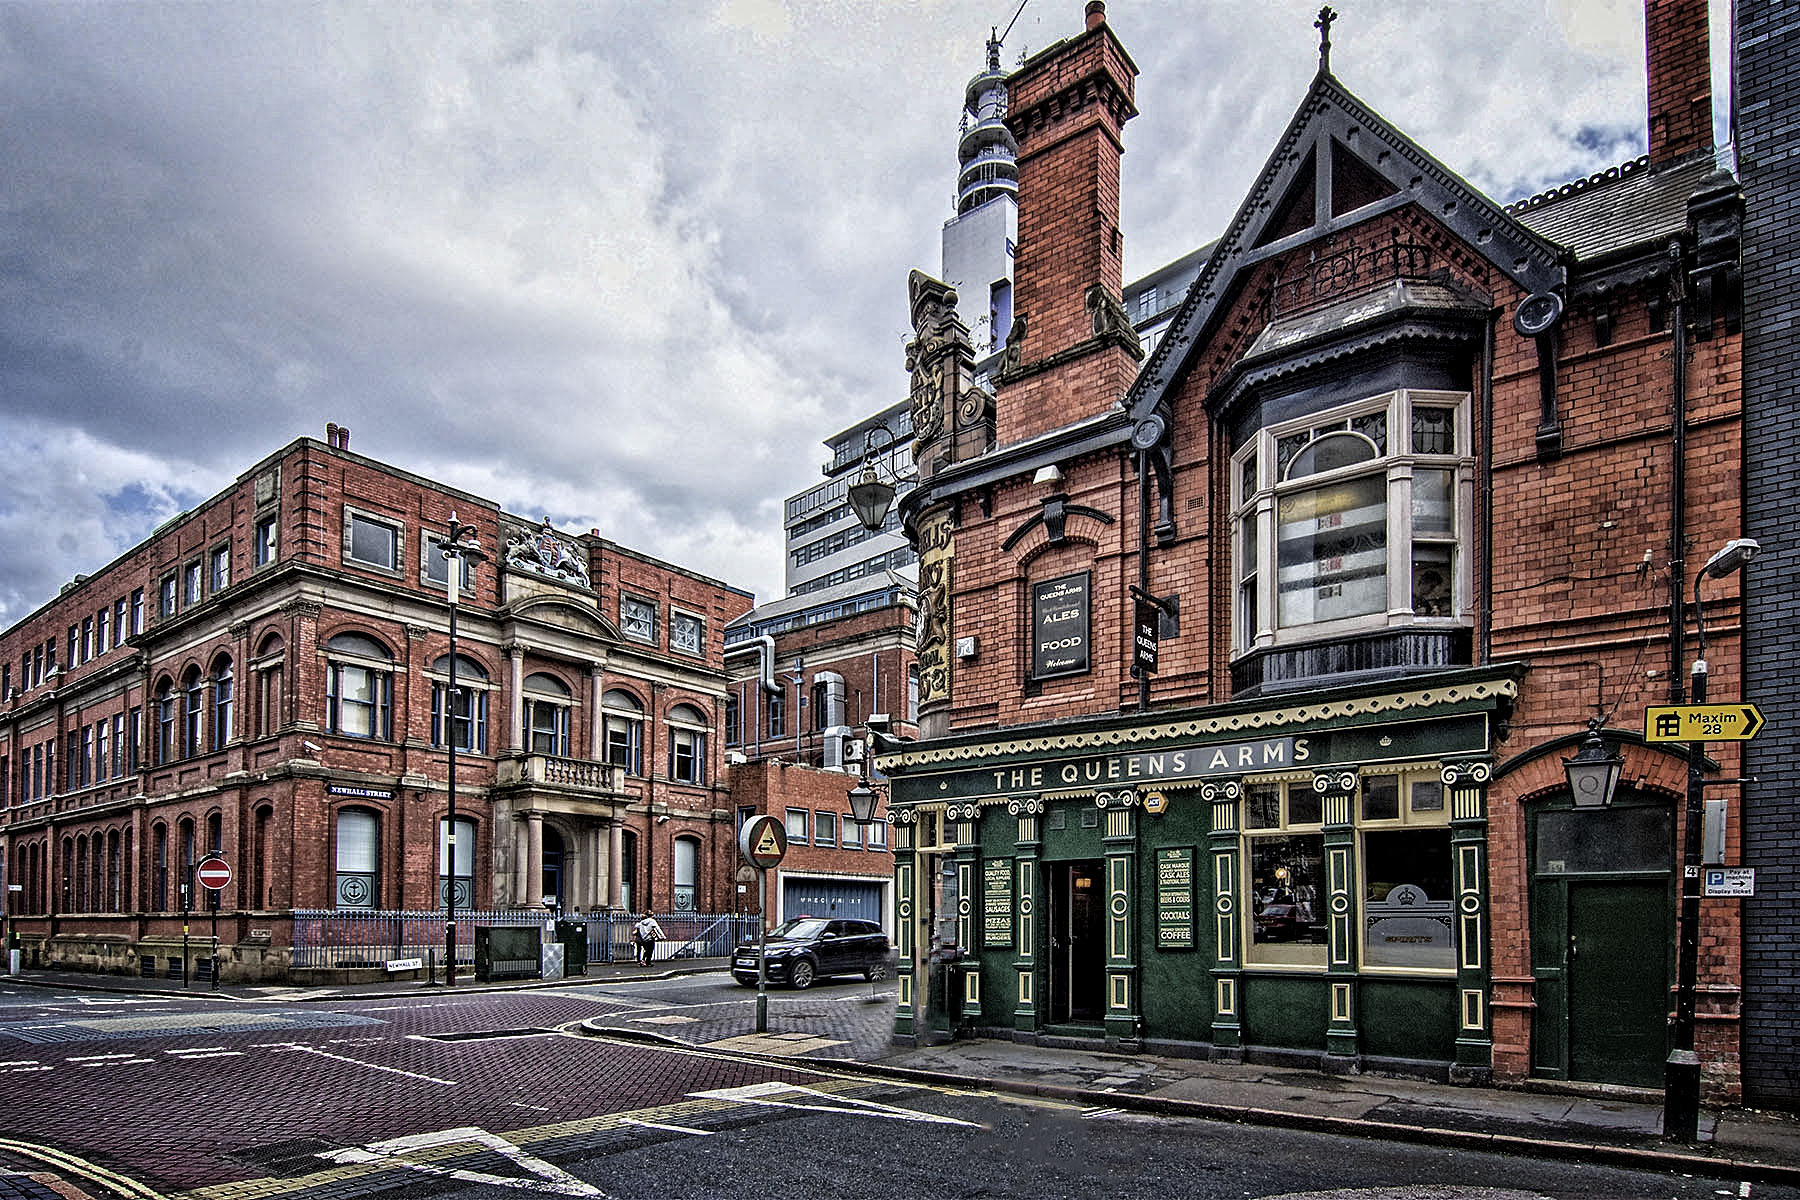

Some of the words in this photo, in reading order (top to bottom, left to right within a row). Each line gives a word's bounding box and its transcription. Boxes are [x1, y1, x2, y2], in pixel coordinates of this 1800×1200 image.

[1040, 590, 1065, 600] QUEENS
[1065, 586, 1082, 595] ARMS
[1043, 609, 1080, 624] ALES
[1142, 624, 1153, 636] THE
[1041, 636, 1082, 652] FOOD
[1136, 635, 1157, 651] QUEENS
[1139, 650, 1154, 663] ARMS
[1046, 659, 1076, 668] Welcome
[1688, 713, 1737, 723] Maxim
[1702, 724, 1722, 735] 28
[994, 768, 1042, 789] THE
[1061, 752, 1186, 783] QUEENS
[1208, 739, 1310, 769] ARMS
[331, 787, 366, 796] NEWHALL
[365, 790, 392, 798] STREET
[1160, 871, 1176, 879] CASK
[1175, 871, 1190, 879] ALES
[1686, 867, 1697, 877] 4
[985, 905, 1011, 913] SAUSAGES
[1160, 911, 1191, 920] COCKTAILS
[1160, 931, 1191, 939] COFFEE
